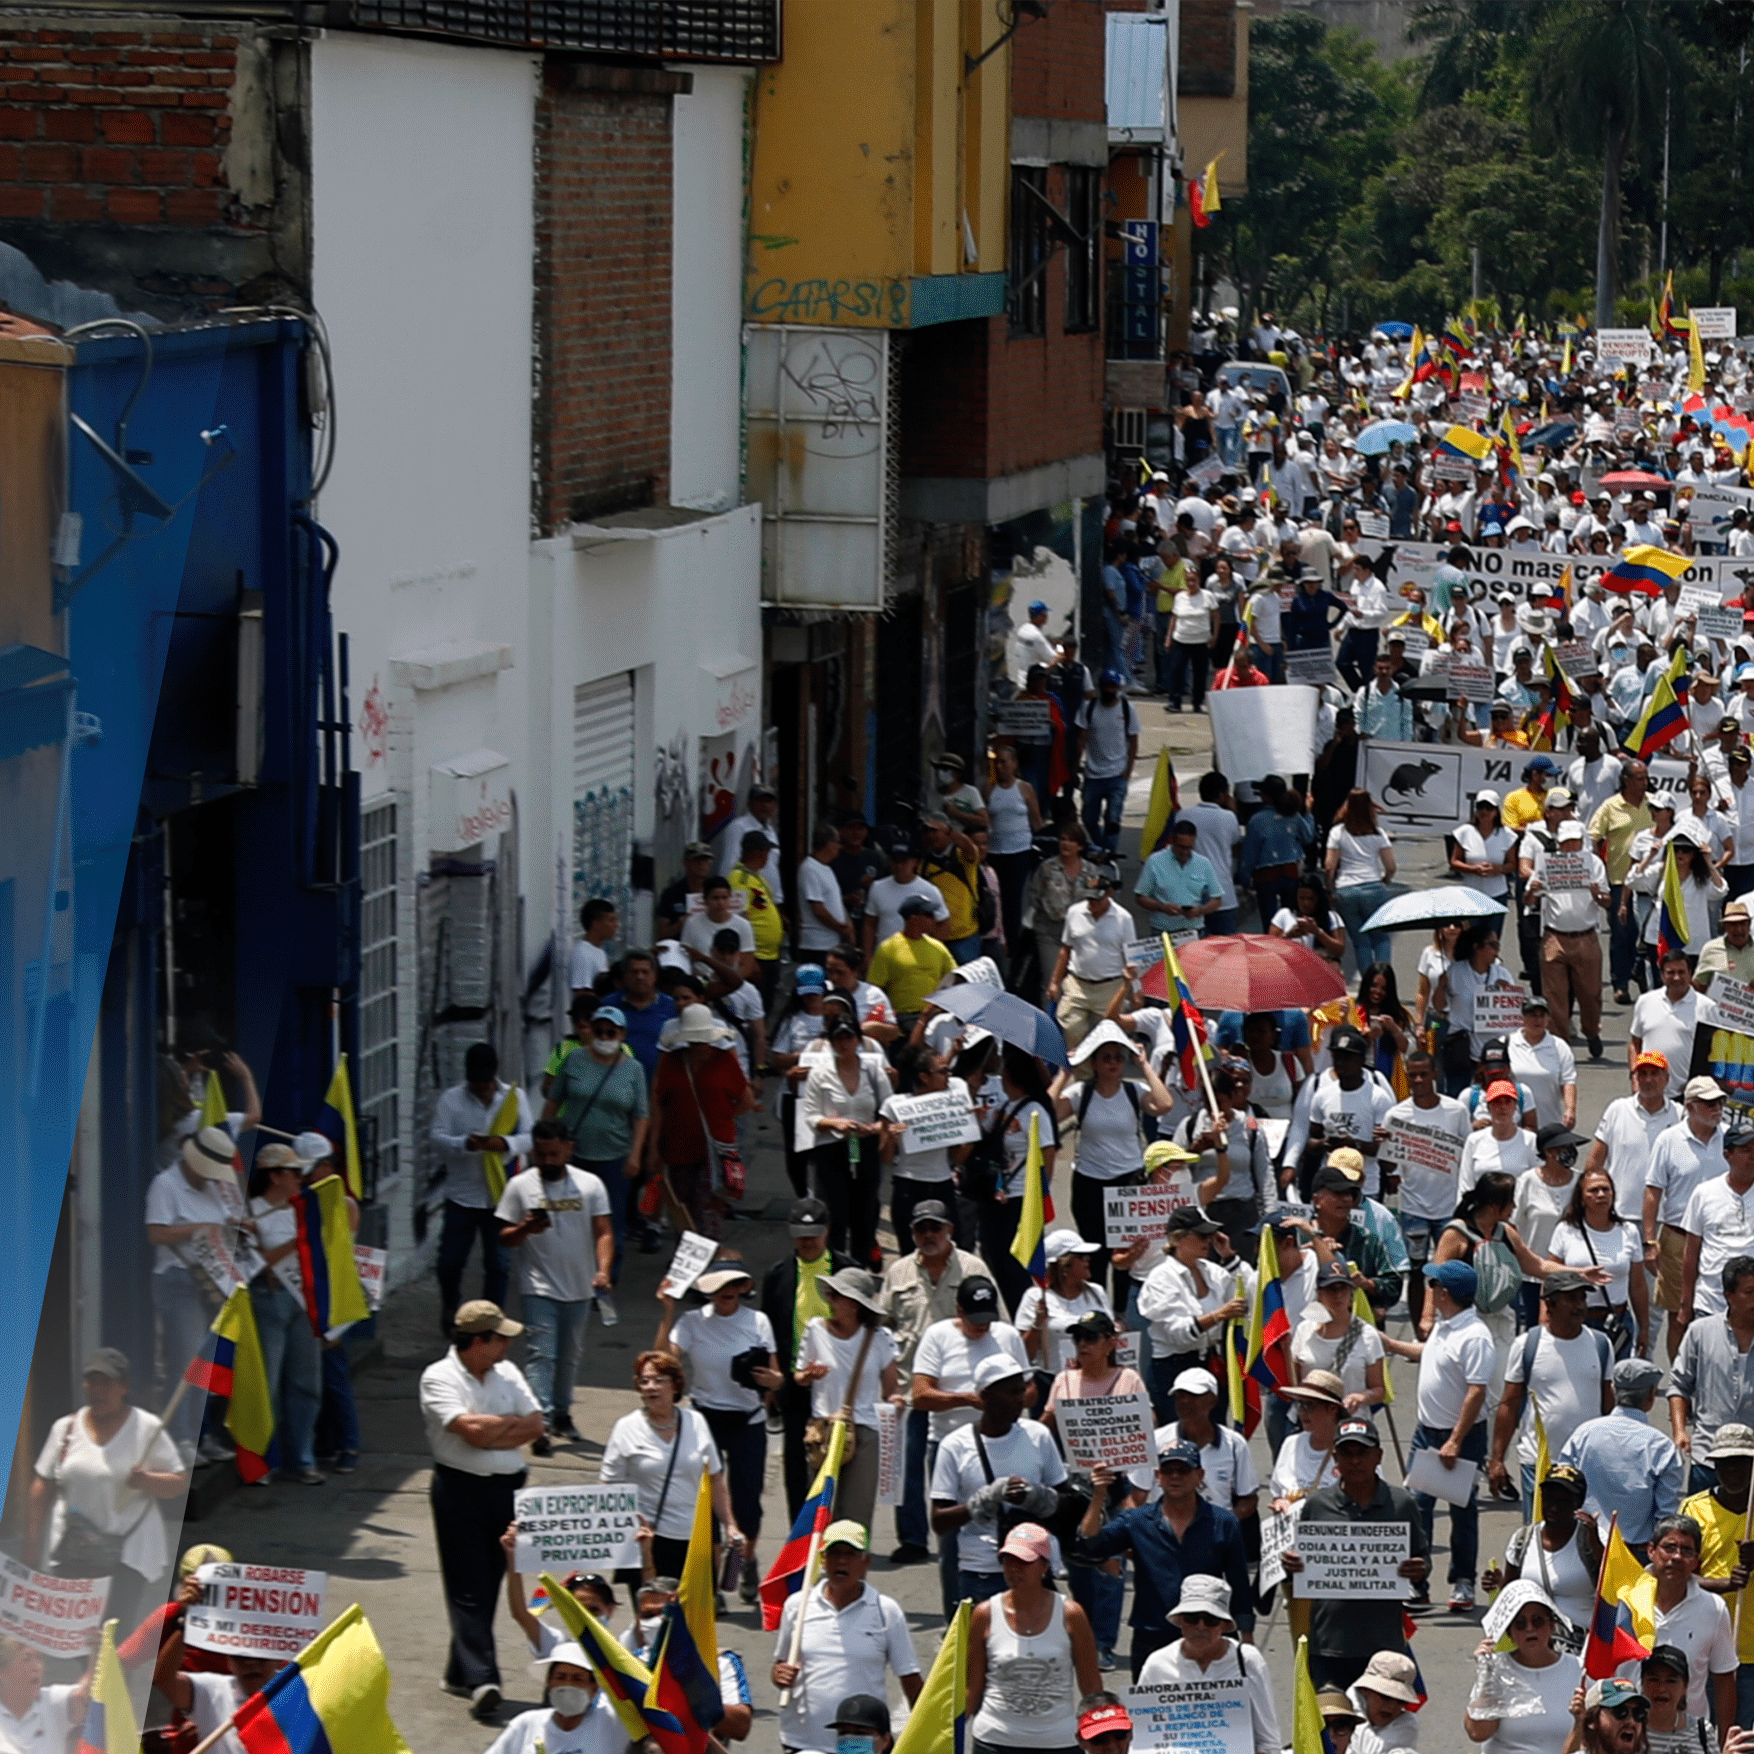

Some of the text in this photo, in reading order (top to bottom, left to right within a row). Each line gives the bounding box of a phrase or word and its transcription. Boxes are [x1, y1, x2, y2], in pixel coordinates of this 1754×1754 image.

[1134, 223, 1149, 338] HOSTAL
[1512, 558, 1565, 579] mas
[1484, 759, 1512, 782] YA
[518, 1516, 634, 1532] RESPETO LA
[532, 1532, 626, 1548] PROPIEDAD
[541, 1547, 612, 1562] PRIVADA
